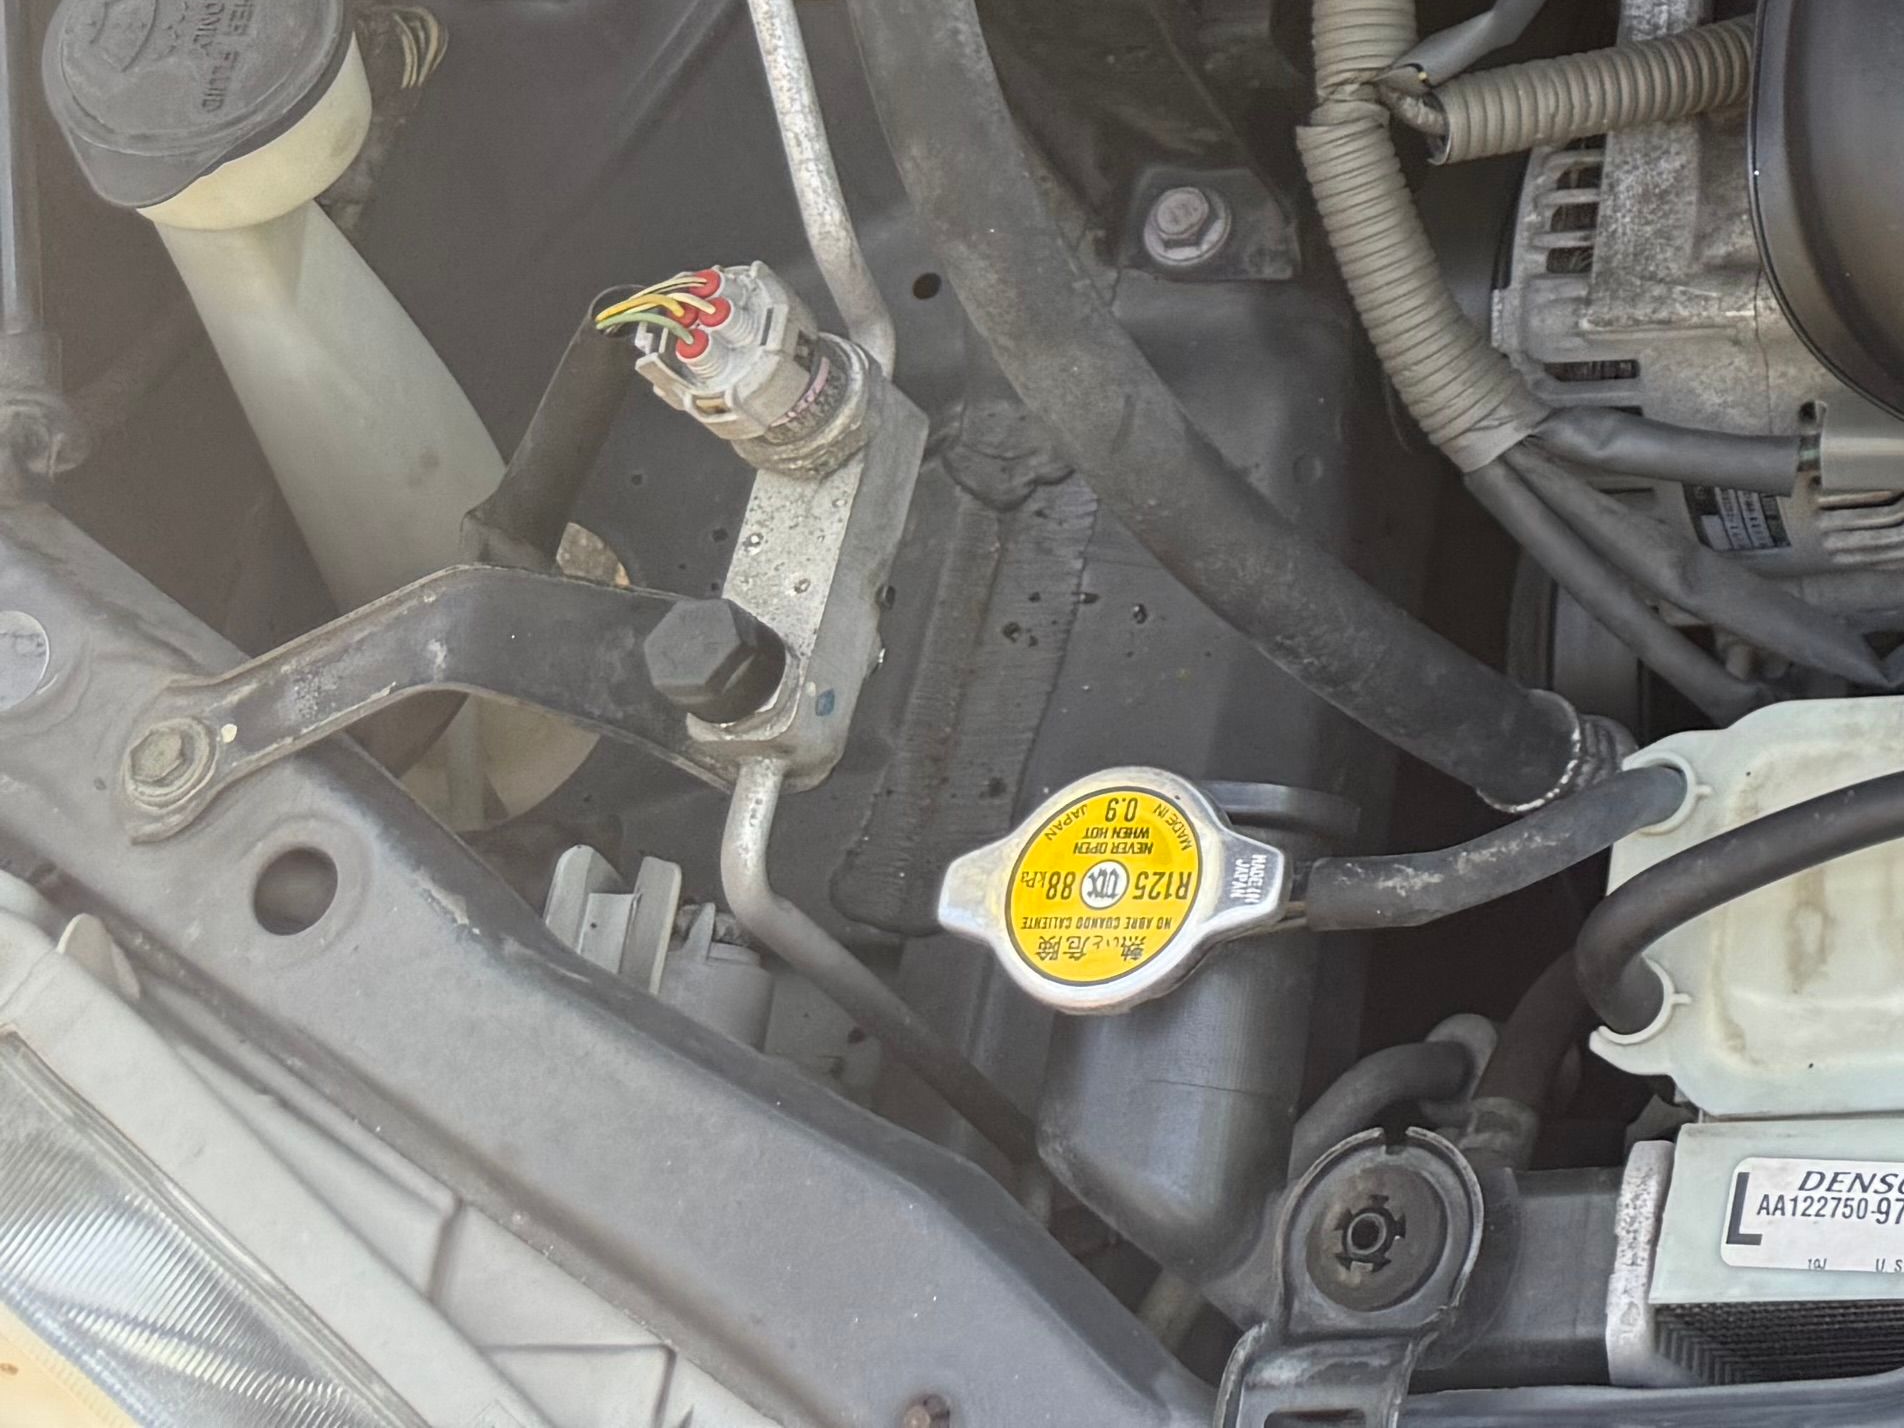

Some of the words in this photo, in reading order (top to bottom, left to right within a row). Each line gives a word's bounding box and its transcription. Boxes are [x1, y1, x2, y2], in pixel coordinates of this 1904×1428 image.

[1104, 796, 1139, 824] 0.9
[1152, 802, 1170, 821] IN
[1042, 803, 1089, 842] JAPAN
[1081, 826, 1109, 840] HOT
[1112, 826, 1150, 840] WHEN
[1168, 813, 1193, 851] MADE
[1072, 841, 1109, 855] OPEN
[1110, 841, 1154, 855] NEVER
[1132, 870, 1193, 901] R125
[1725, 1171, 1763, 1246] L
